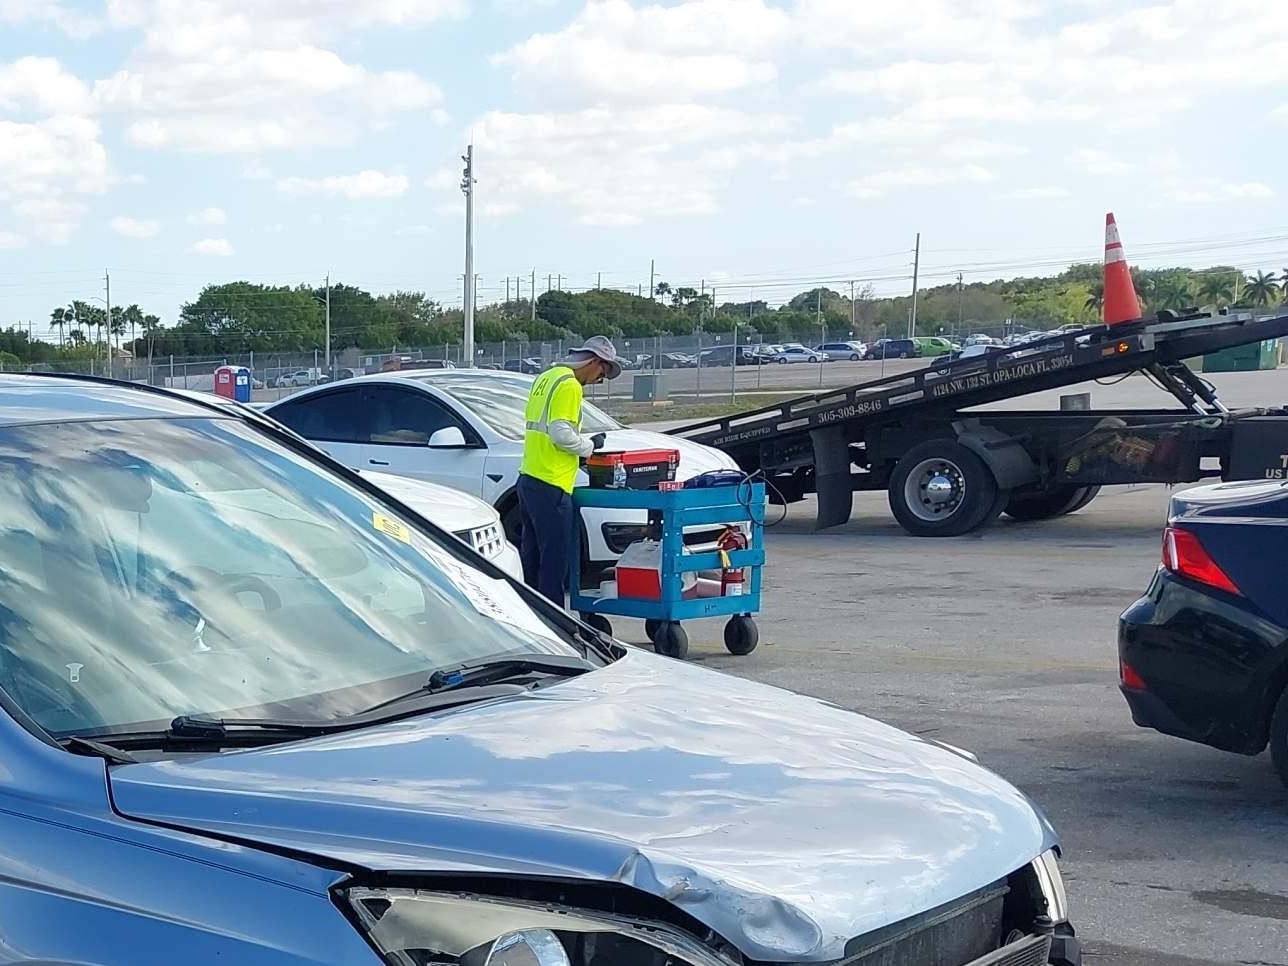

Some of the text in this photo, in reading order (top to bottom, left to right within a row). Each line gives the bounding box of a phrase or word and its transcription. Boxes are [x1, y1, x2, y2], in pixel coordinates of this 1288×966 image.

[993, 362, 1035, 383] OPA-LOCA
[1050, 354, 1073, 369] 33054
[818, 399, 882, 424] 305-303-8846
[1265, 468, 1283, 479] US
